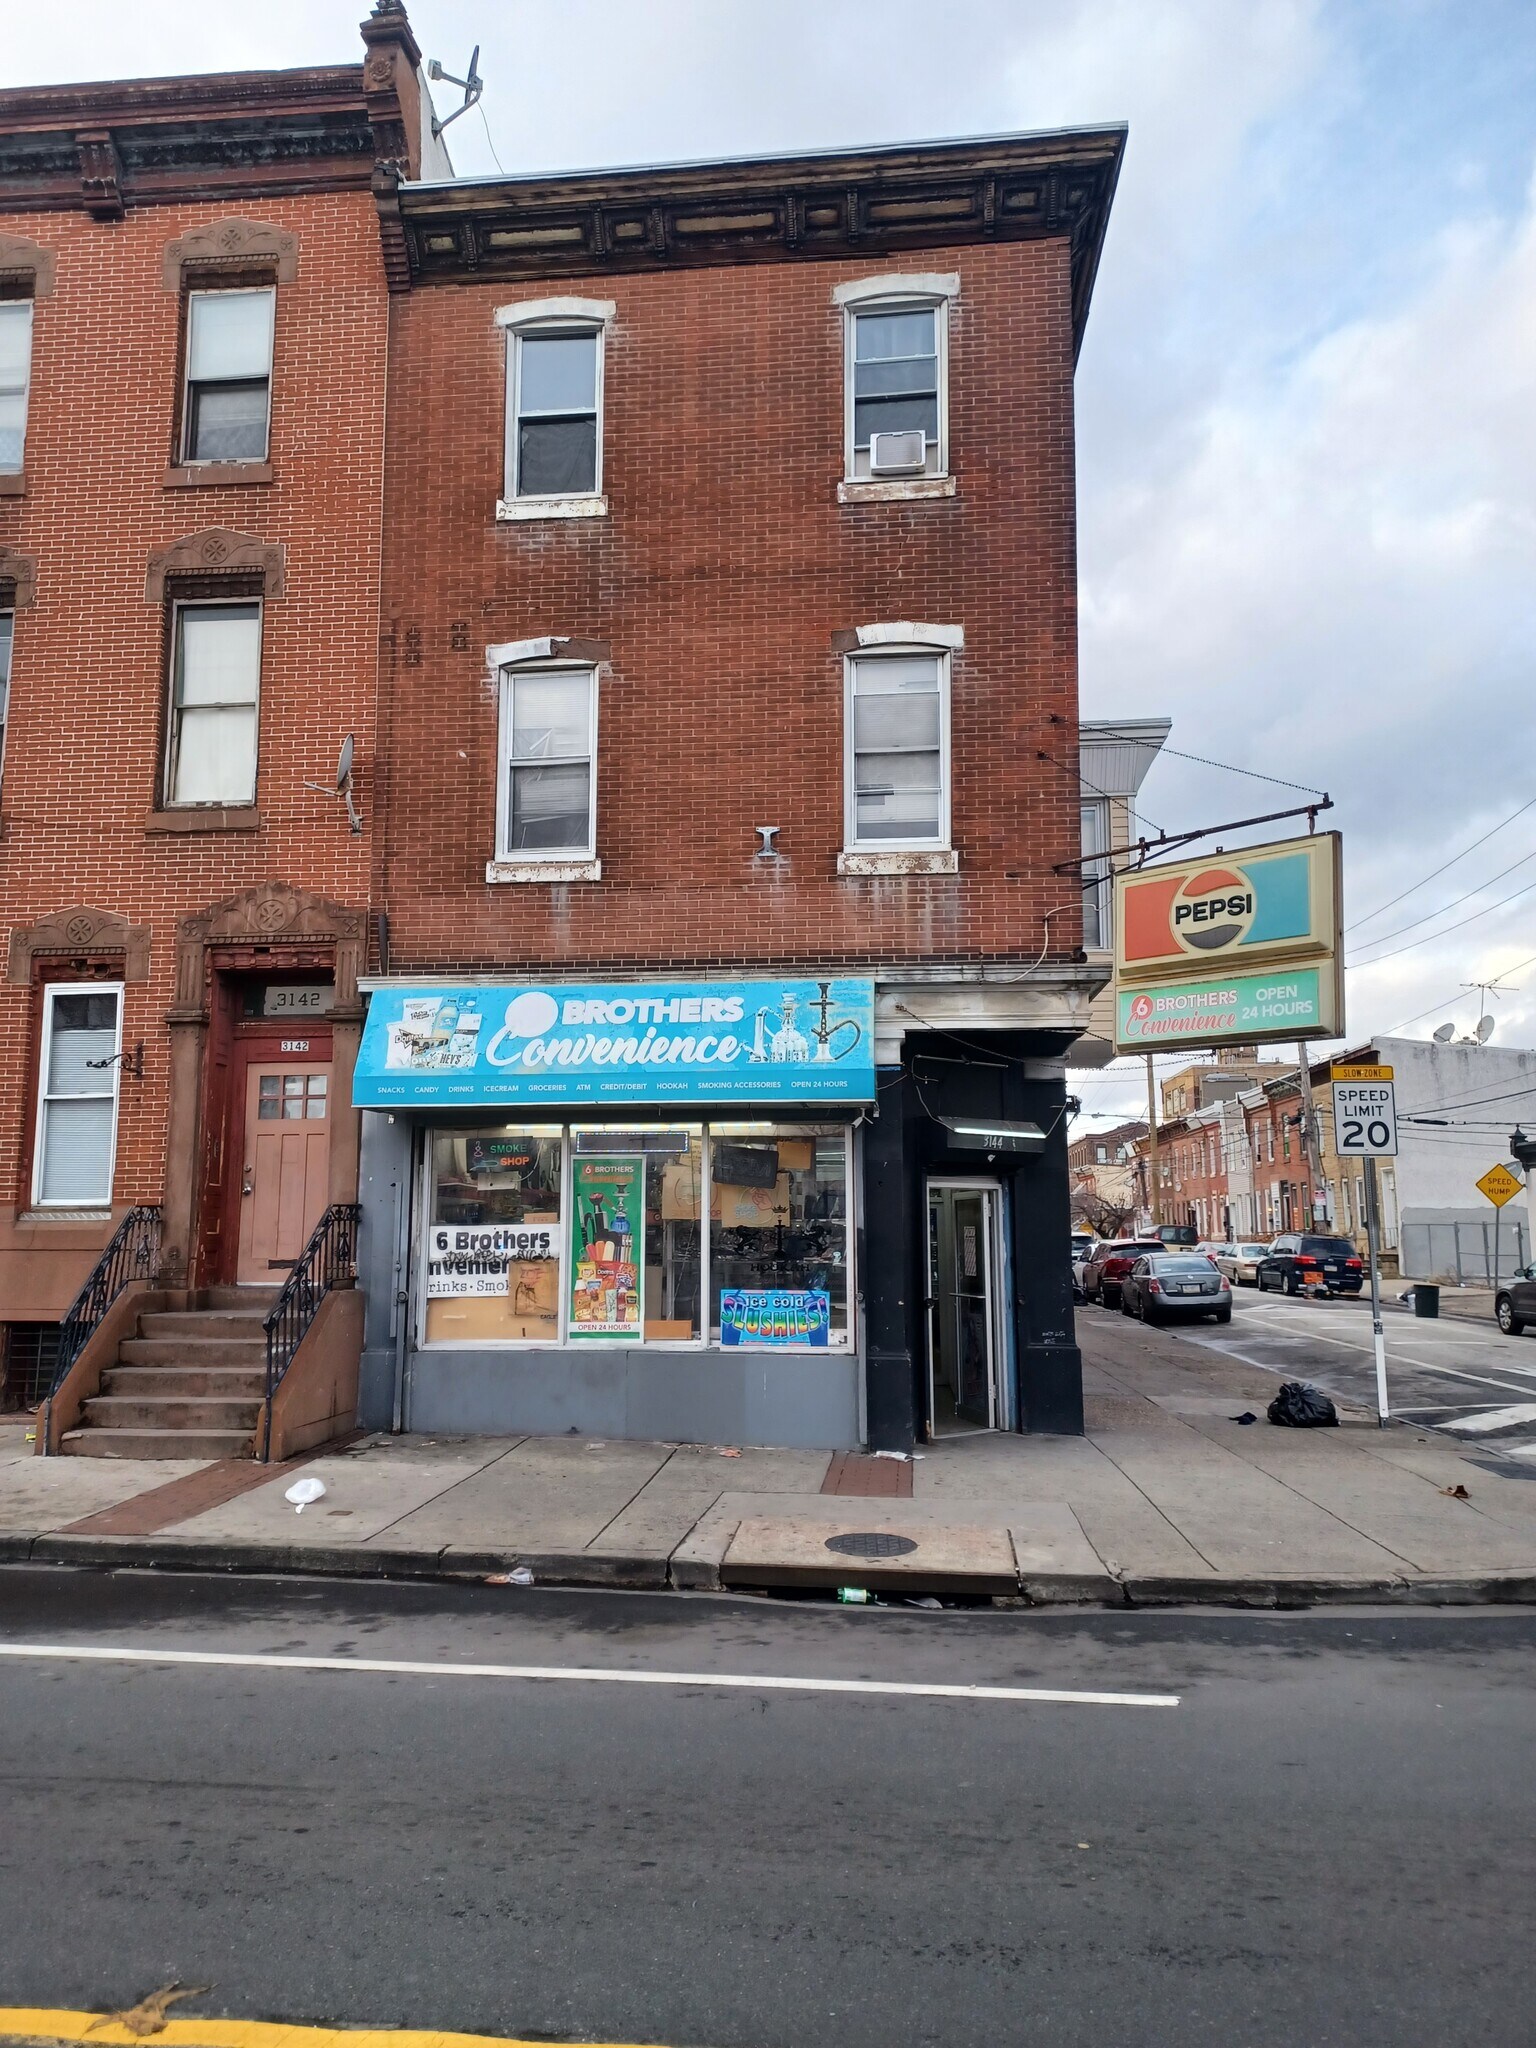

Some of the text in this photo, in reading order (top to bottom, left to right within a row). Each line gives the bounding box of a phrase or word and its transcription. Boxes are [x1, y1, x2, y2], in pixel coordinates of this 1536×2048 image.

[1175, 893, 1252, 925] PEPSI
[276, 992, 321, 1007] 3142
[1256, 985, 1298, 1001] OPEN
[1136, 989, 1238, 1017] 6 BROTHERS
[1242, 1000, 1313, 1020] 24 HOURS
[562, 996, 745, 1025] BROTHERS
[1126, 1011, 1236, 1037] Convenience
[282, 1041, 308, 1051] 3142
[485, 1026, 742, 1067] Convenience
[1343, 1068, 1383, 1078] SLOW ZONE
[377, 1086, 405, 1094] SNACKS
[448, 1085, 474, 1093] DRINKS
[656, 1082, 689, 1090] HOOKAH
[697, 1081, 732, 1089] SMOKING
[734, 1081, 781, 1089] ACCESSORIES
[790, 1080, 812, 1088] OPEN
[813, 1080, 821, 1088] 24
[823, 1080, 848, 1088] HOURS
[1338, 1090, 1389, 1102] SPEED
[1344, 1105, 1384, 1117] LIMIT
[1342, 1120, 1390, 1148] 20
[490, 1143, 528, 1154] SMOKE
[983, 1135, 1003, 1149] 3144
[500, 1156, 530, 1166] SHOP
[585, 1165, 634, 1174] 6 BROTHERS
[1487, 1178, 1512, 1186] SPEED
[1488, 1187, 1511, 1195] HUMP
[436, 1230, 551, 1250] 6 Brothers
[428, 1280, 468, 1293] rinks
[746, 1294, 805, 1309] ice cold
[721, 1297, 829, 1339] SLUSHIES!
[608, 1323, 632, 1331] HOURS
